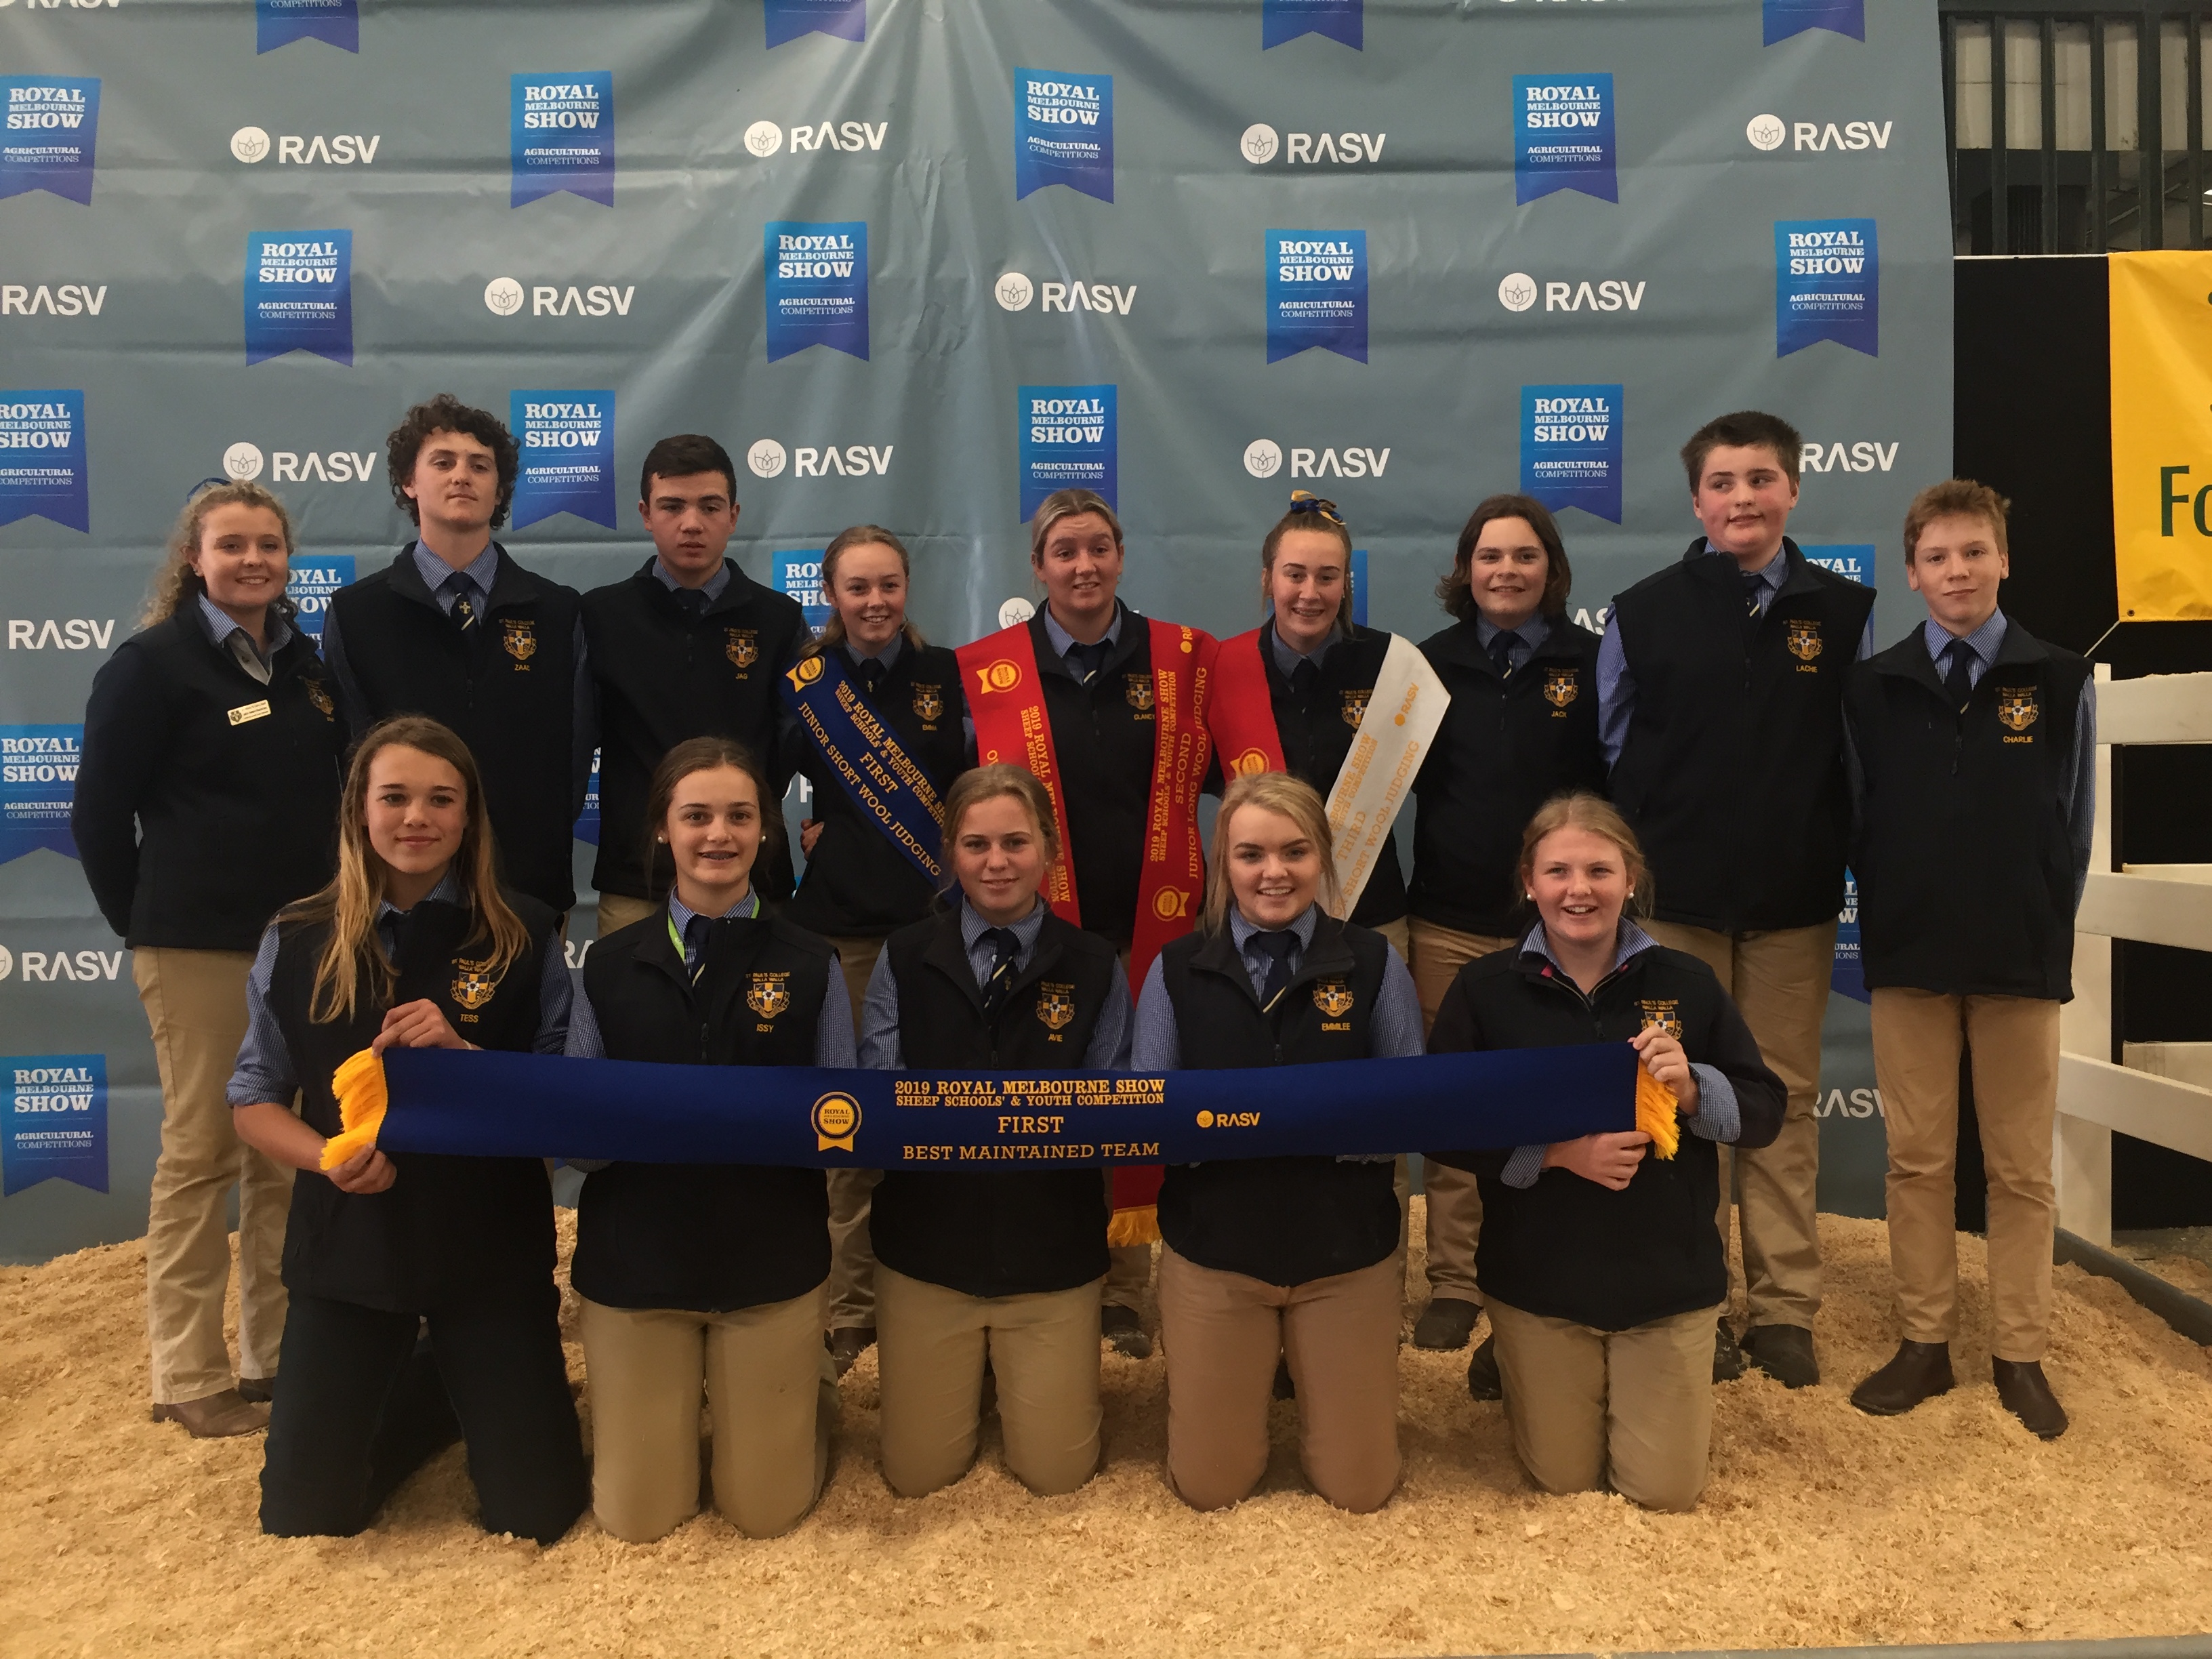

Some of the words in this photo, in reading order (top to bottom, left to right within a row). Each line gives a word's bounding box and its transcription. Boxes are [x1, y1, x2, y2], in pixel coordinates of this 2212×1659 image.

[9, 87, 85, 103] ROYAL
[525, 85, 598, 100] ROYAL
[1027, 81, 1099, 100] ROYAL
[1527, 86, 1600, 101] ROYAL
[9, 104, 85, 112] MELBOURNE
[525, 101, 599, 110] MELBOURNE
[1027, 96, 1100, 110] MELBOURNE
[1527, 102, 1600, 110] MELBOURNE
[7, 113, 84, 129] SHOW
[525, 111, 599, 129] SHOW
[1027, 106, 1099, 125] SHOW
[1527, 112, 1601, 128] SHOW
[791, 122, 888, 153] RASV
[1027, 137, 1100, 150] AGRICULTURAL
[1795, 121, 1892, 150] RASV
[3, 146, 81, 155] AGRICULTURAL
[279, 136, 380, 163] RASV
[524, 148, 601, 157] AGRICULTURAL
[1029, 145, 1099, 159] COMPETITIONS
[1288, 133, 1385, 163] RASV
[1528, 145, 1602, 153] AGRICULTURAL
[527, 157, 599, 166] COMPETITIONS
[1530, 154, 1601, 162] COMPETITIONS
[779, 234, 853, 250] ROYAL
[1789, 232, 1864, 247] ROYAL
[262, 243, 337, 258] ROYAL
[779, 251, 853, 260] MELBOURNE
[1279, 241, 1353, 255] ROYAL
[261, 258, 337, 266] MELBOURNE
[1279, 256, 1353, 264] MELBOURNE
[1790, 258, 1864, 275] SHOW
[259, 267, 337, 283] SHOW
[779, 262, 853, 278] SHOW
[1279, 266, 1353, 282] SHOW
[2, 286, 106, 315] RASV
[533, 286, 634, 316] RASV
[1042, 282, 1136, 315] RASV
[1547, 281, 1645, 311] RASV
[1789, 293, 1865, 302] AGRICULTURAL
[258, 302, 337, 310] AGRICULTURAL
[781, 306, 853, 314] COMPETITIONS
[1279, 301, 1354, 309] AGRICULTURAL
[1792, 302, 1864, 311] COMPETITIONS
[260, 310, 335, 319] COMPETITIONS
[1281, 309, 1353, 318] COMPETITIONS
[525, 403, 601, 419] ROYAL
[1031, 399, 1104, 414] ROYAL
[1535, 398, 1609, 413] ROYAL
[525, 421, 601, 430] MELBOURNE
[1031, 416, 1103, 425] MELBOURNE
[1534, 415, 1609, 423] MELBOURNE
[525, 430, 601, 448] SHOW
[1031, 427, 1104, 443] SHOW
[1534, 426, 1609, 441] SHOW
[796, 446, 893, 477] RASV
[1291, 449, 1391, 478] RASV
[1533, 461, 1609, 469] AGRICULTURAL
[1799, 443, 1899, 472] RASV
[273, 453, 376, 482] RASV
[525, 466, 601, 475] AGRICULTURAL
[1030, 462, 1105, 470] AGRICULTURAL
[1535, 470, 1607, 478] COMPETITIONS
[527, 474, 599, 483] COMPETITIONS
[1033, 470, 1103, 479] COMPETITIONS
[9, 620, 115, 650] RASV
[1158, 668, 1169, 704] SHOW
[1193, 667, 1207, 731] JUDGING
[1401, 682, 1420, 715] RASV
[1020, 710, 1033, 738] SHEEP
[1029, 705, 1042, 730] 2019
[834, 688, 853, 714] SHEEP
[880, 749, 888, 758] &
[888, 755, 914, 786] YOUTH
[838, 680, 855, 702] 2019
[853, 701, 885, 739] ROYAL
[882, 735, 937, 801] MELBOURNE
[1, 738, 79, 754] ROYAL
[1157, 706, 1169, 785] MELBOURNE
[1166, 733, 1174, 771] YOUTH
[1351, 732, 1372, 772] SHOW
[3, 755, 80, 764] MELBOURNE
[1033, 733, 1052, 778] ROYAL
[1191, 733, 1206, 777] WOOL
[3, 765, 80, 782] SHOW
[859, 752, 899, 794] FIRST
[1166, 772, 1172, 781] &
[1175, 733, 1191, 805] SECOND
[1349, 739, 1378, 801] COMPETITION
[799, 701, 830, 747] JUNIOR
[827, 745, 861, 785] SHORT
[858, 784, 890, 825] WOOL
[889, 821, 941, 876] JUDGING
[4, 802, 73, 810] AGRICULTURA
[1188, 779, 1197, 824] LONG
[1153, 789, 1165, 834] ROYAL
[1344, 845, 1370, 897] SHORT
[1365, 805, 1392, 848] WOOL
[1384, 740, 1420, 807] JUDGING
[1336, 810, 1366, 862] THIRD
[1150, 836, 1160, 862] 2019
[1189, 829, 1198, 879] JUNIOR
[1054, 865, 1071, 903] SHOW
[22, 951, 123, 981] RASV
[460, 1014, 479, 1023] TESS
[756, 1024, 774, 1033] ISSY
[14, 1068, 92, 1084] ROYAL
[15, 1085, 94, 1094] MELBOURNE
[895, 1081, 930, 1095] 2019
[937, 1081, 996, 1094] ROYAL
[1003, 1080, 1109, 1094] MELBOURNE
[1116, 1080, 1165, 1092] SHOW
[14, 1095, 93, 1112] SHOW
[896, 1094, 939, 1107] SHEEP
[945, 1094, 1005, 1107] SCHOOLS'
[1011, 1096, 1021, 1106] &
[1026, 1094, 1071, 1105] YOUTH
[1076, 1093, 1164, 1105] COMPETITION
[998, 1117, 1063, 1133] FIRST
[1217, 1113, 1260, 1127] RASV
[14, 1132, 93, 1140] AGRICULTURAL
[17, 1141, 91, 1149] COMPETITIONS
[903, 1145, 953, 1160] BEST
[960, 1145, 1094, 1160] MAINTAINED
[1102, 1143, 1159, 1157] TEAM
